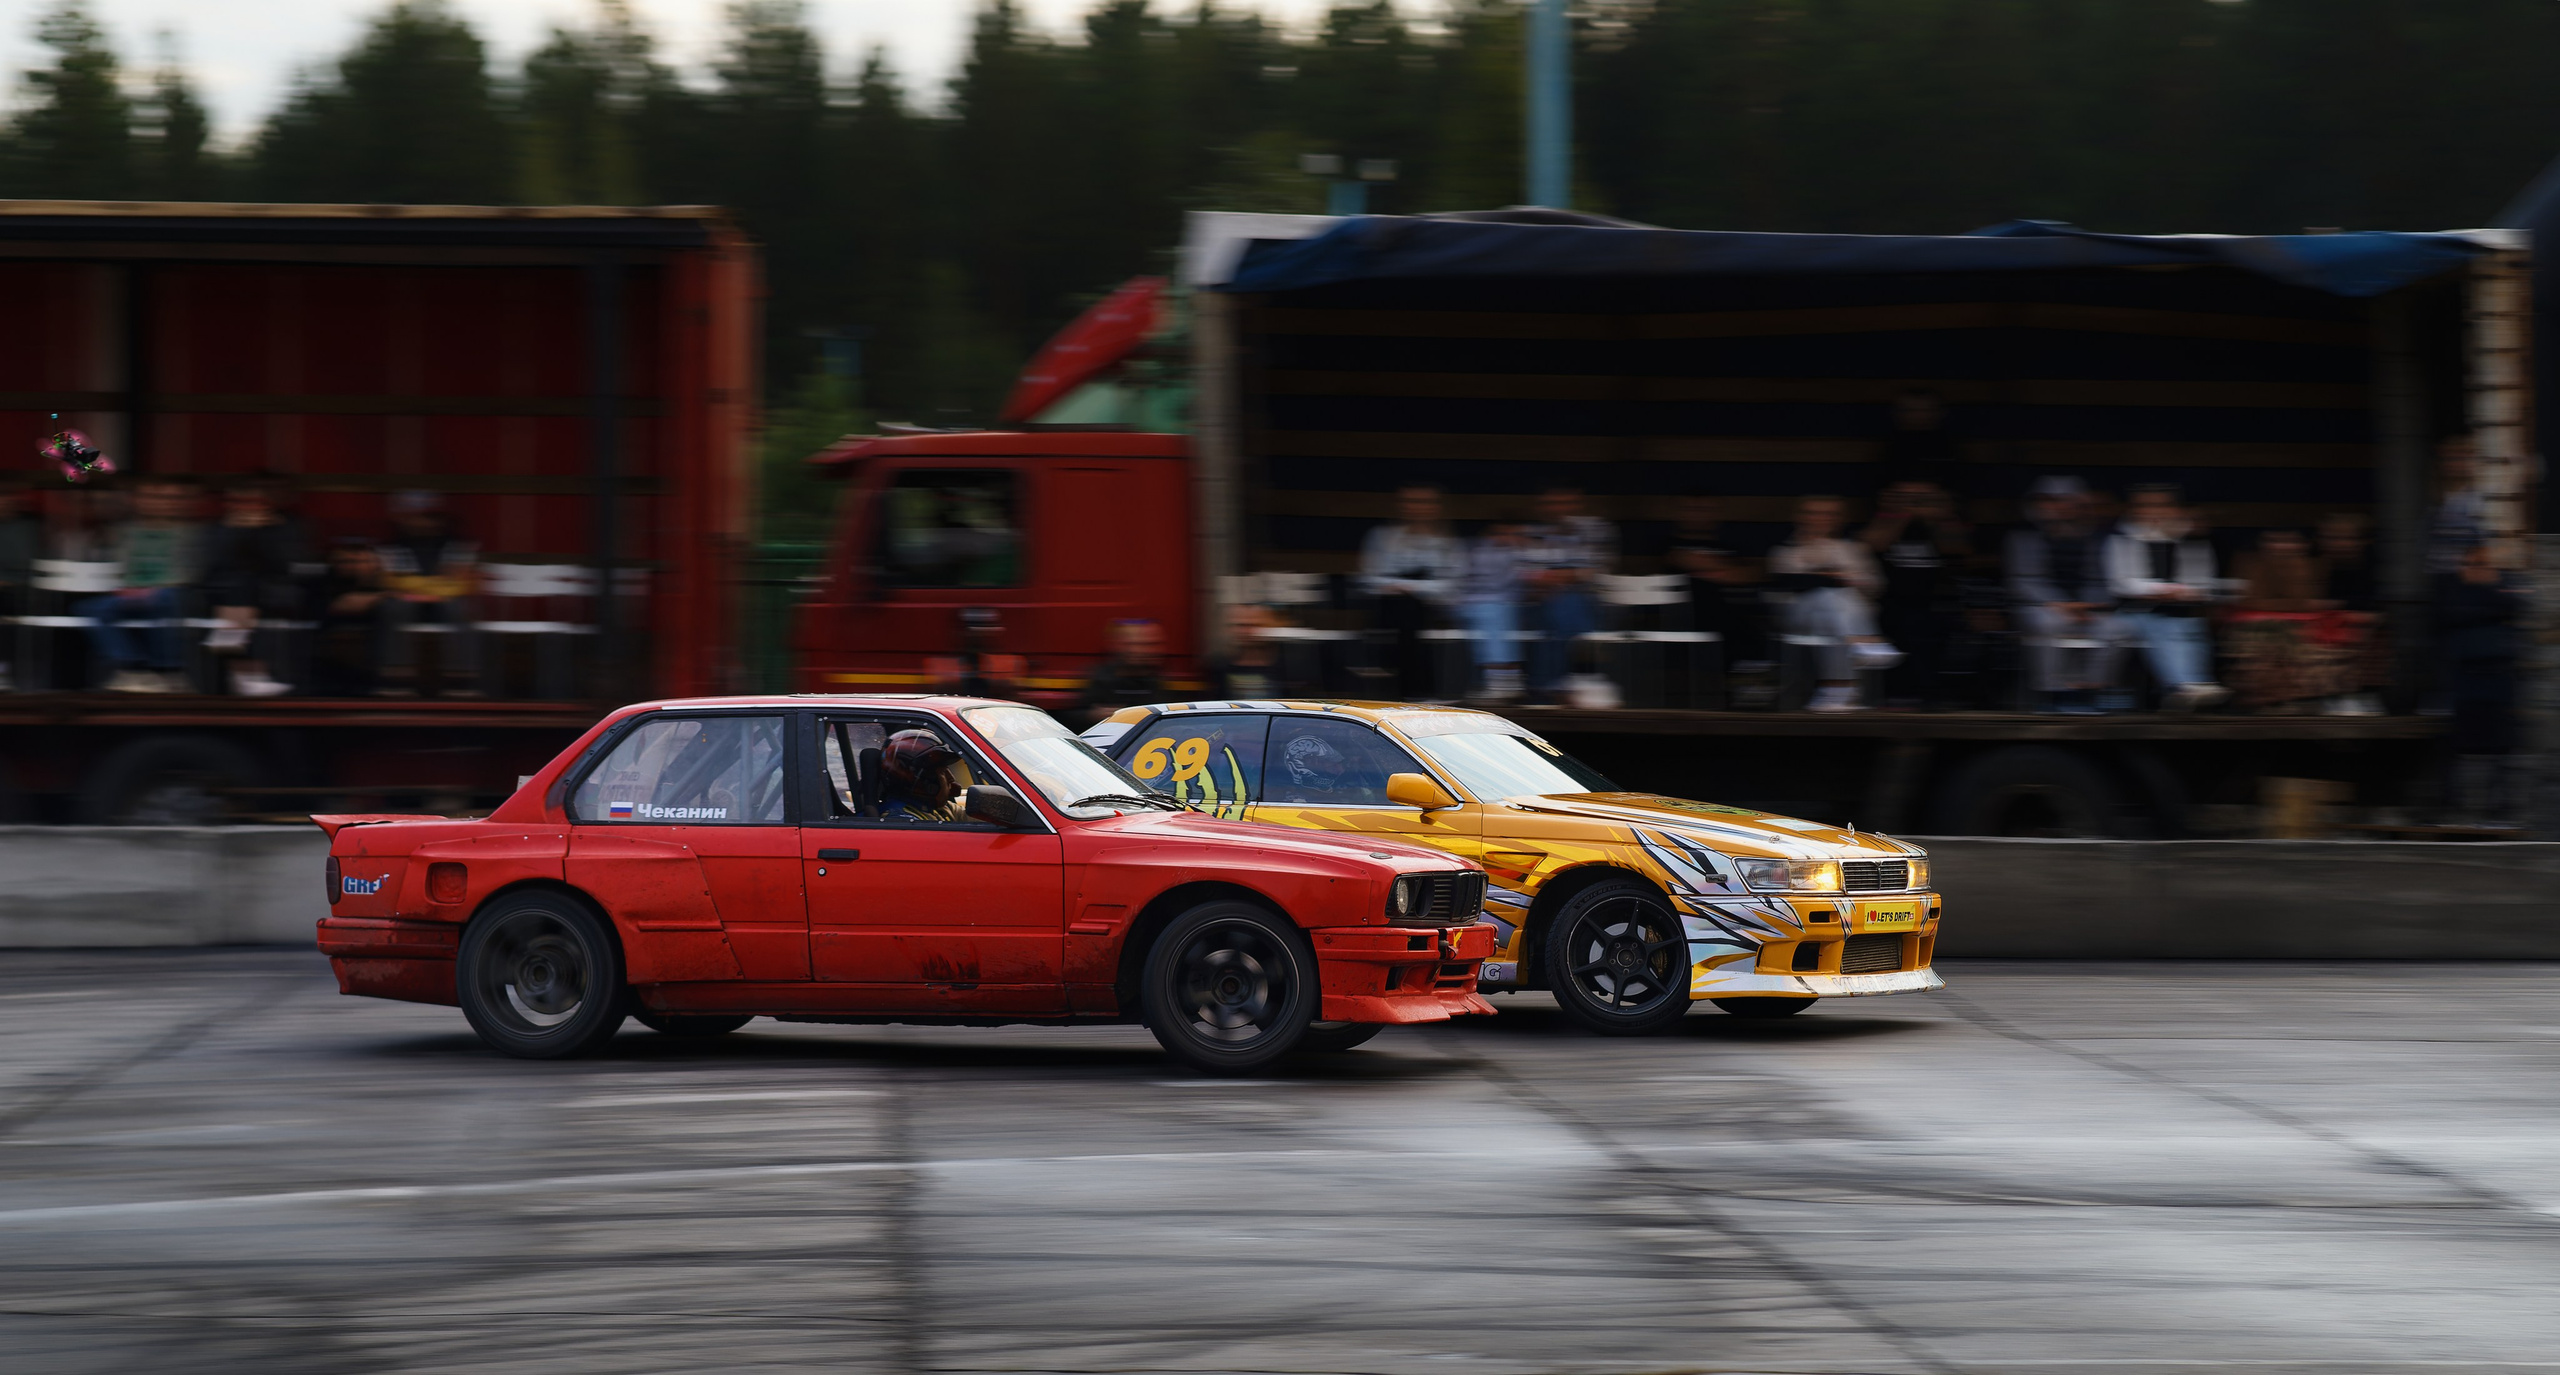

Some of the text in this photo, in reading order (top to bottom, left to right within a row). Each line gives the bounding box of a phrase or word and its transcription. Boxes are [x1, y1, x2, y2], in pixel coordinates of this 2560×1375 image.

[1132, 737, 1210, 781] 69
[638, 803, 727, 819] Чеканин
[1877, 912, 1894, 922] LET'S
[1894, 911, 1911, 922] DRIFT
